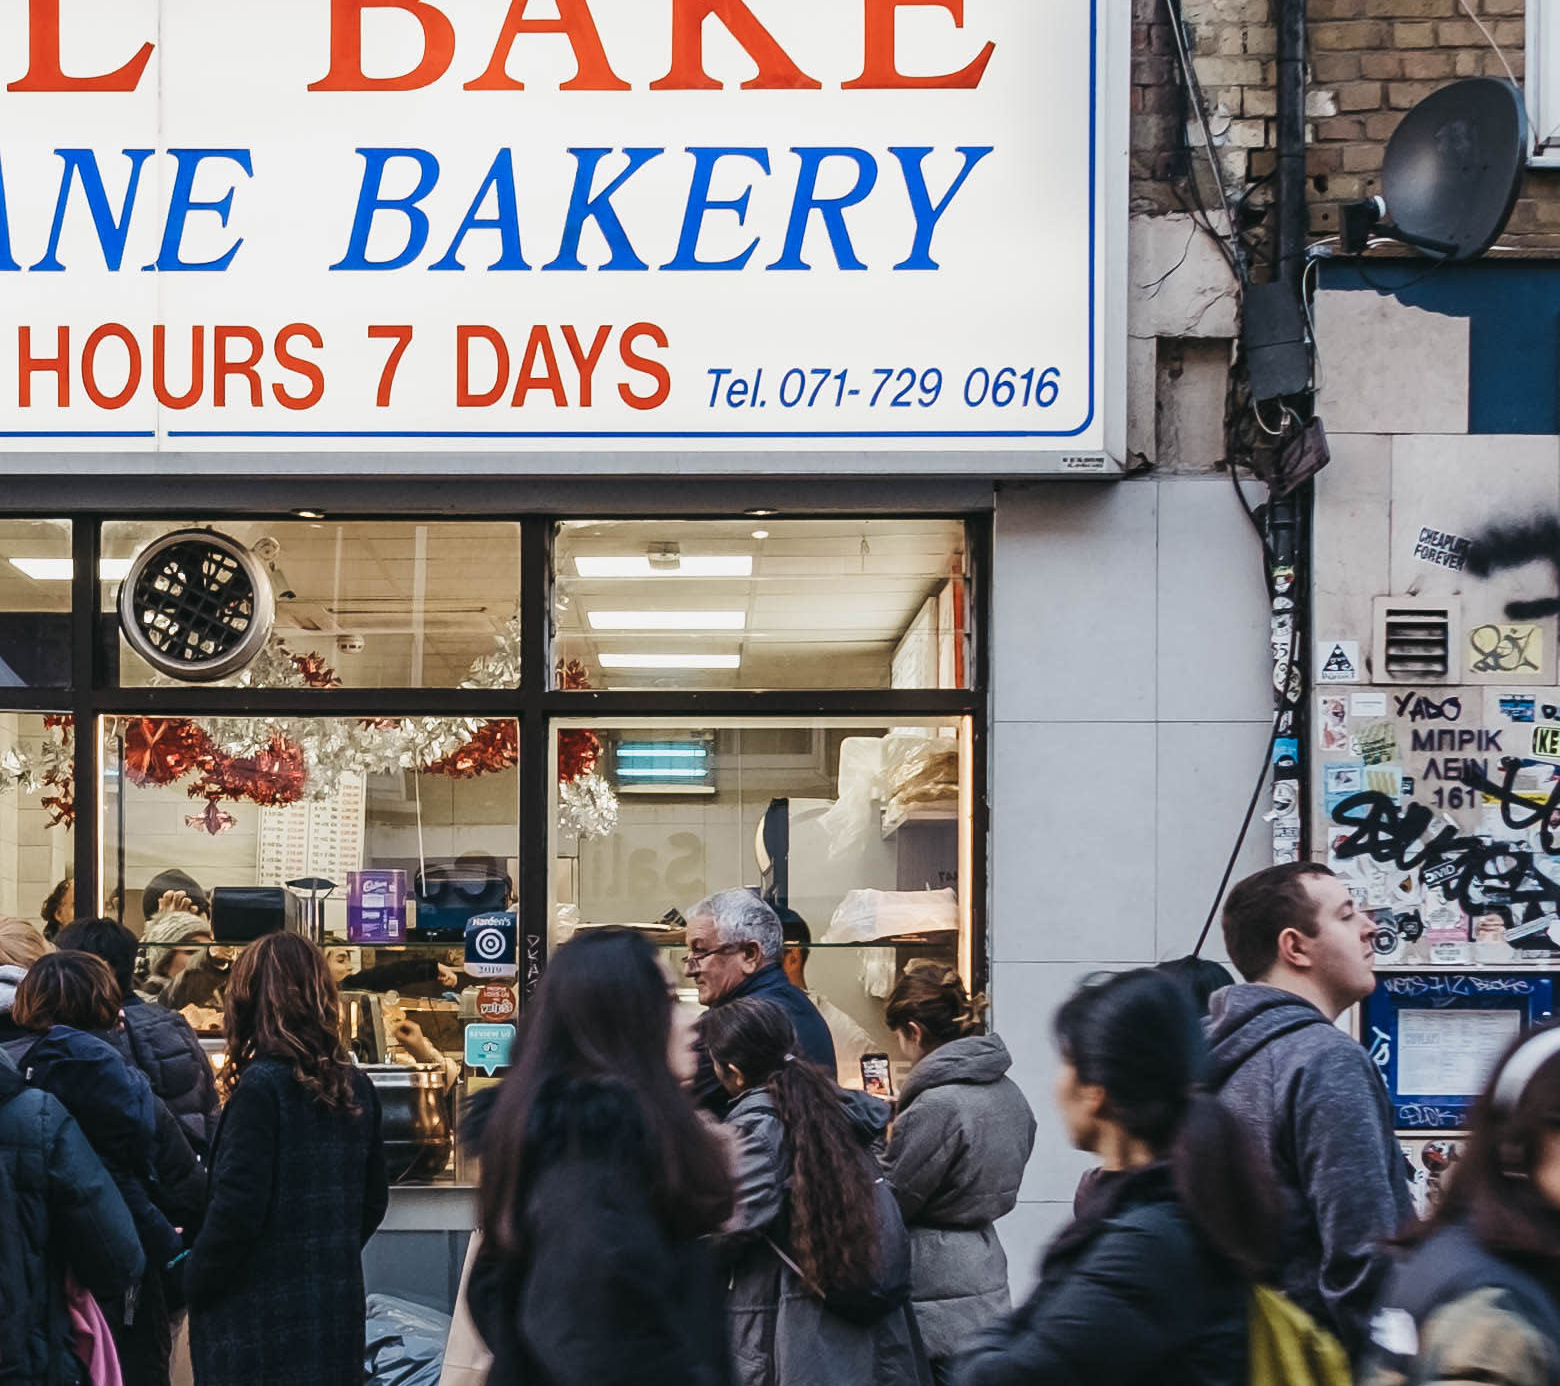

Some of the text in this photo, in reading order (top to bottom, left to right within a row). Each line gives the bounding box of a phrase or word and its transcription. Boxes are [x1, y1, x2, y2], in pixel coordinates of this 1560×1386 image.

[329, 145, 993, 272] BAKERY
[17, 321, 325, 411] HOURS
[367, 324, 414, 408] 7
[456, 321, 671, 411] DAYS
[964, 366, 1061, 409] 0616
[1432, 786, 1477, 810] 161
